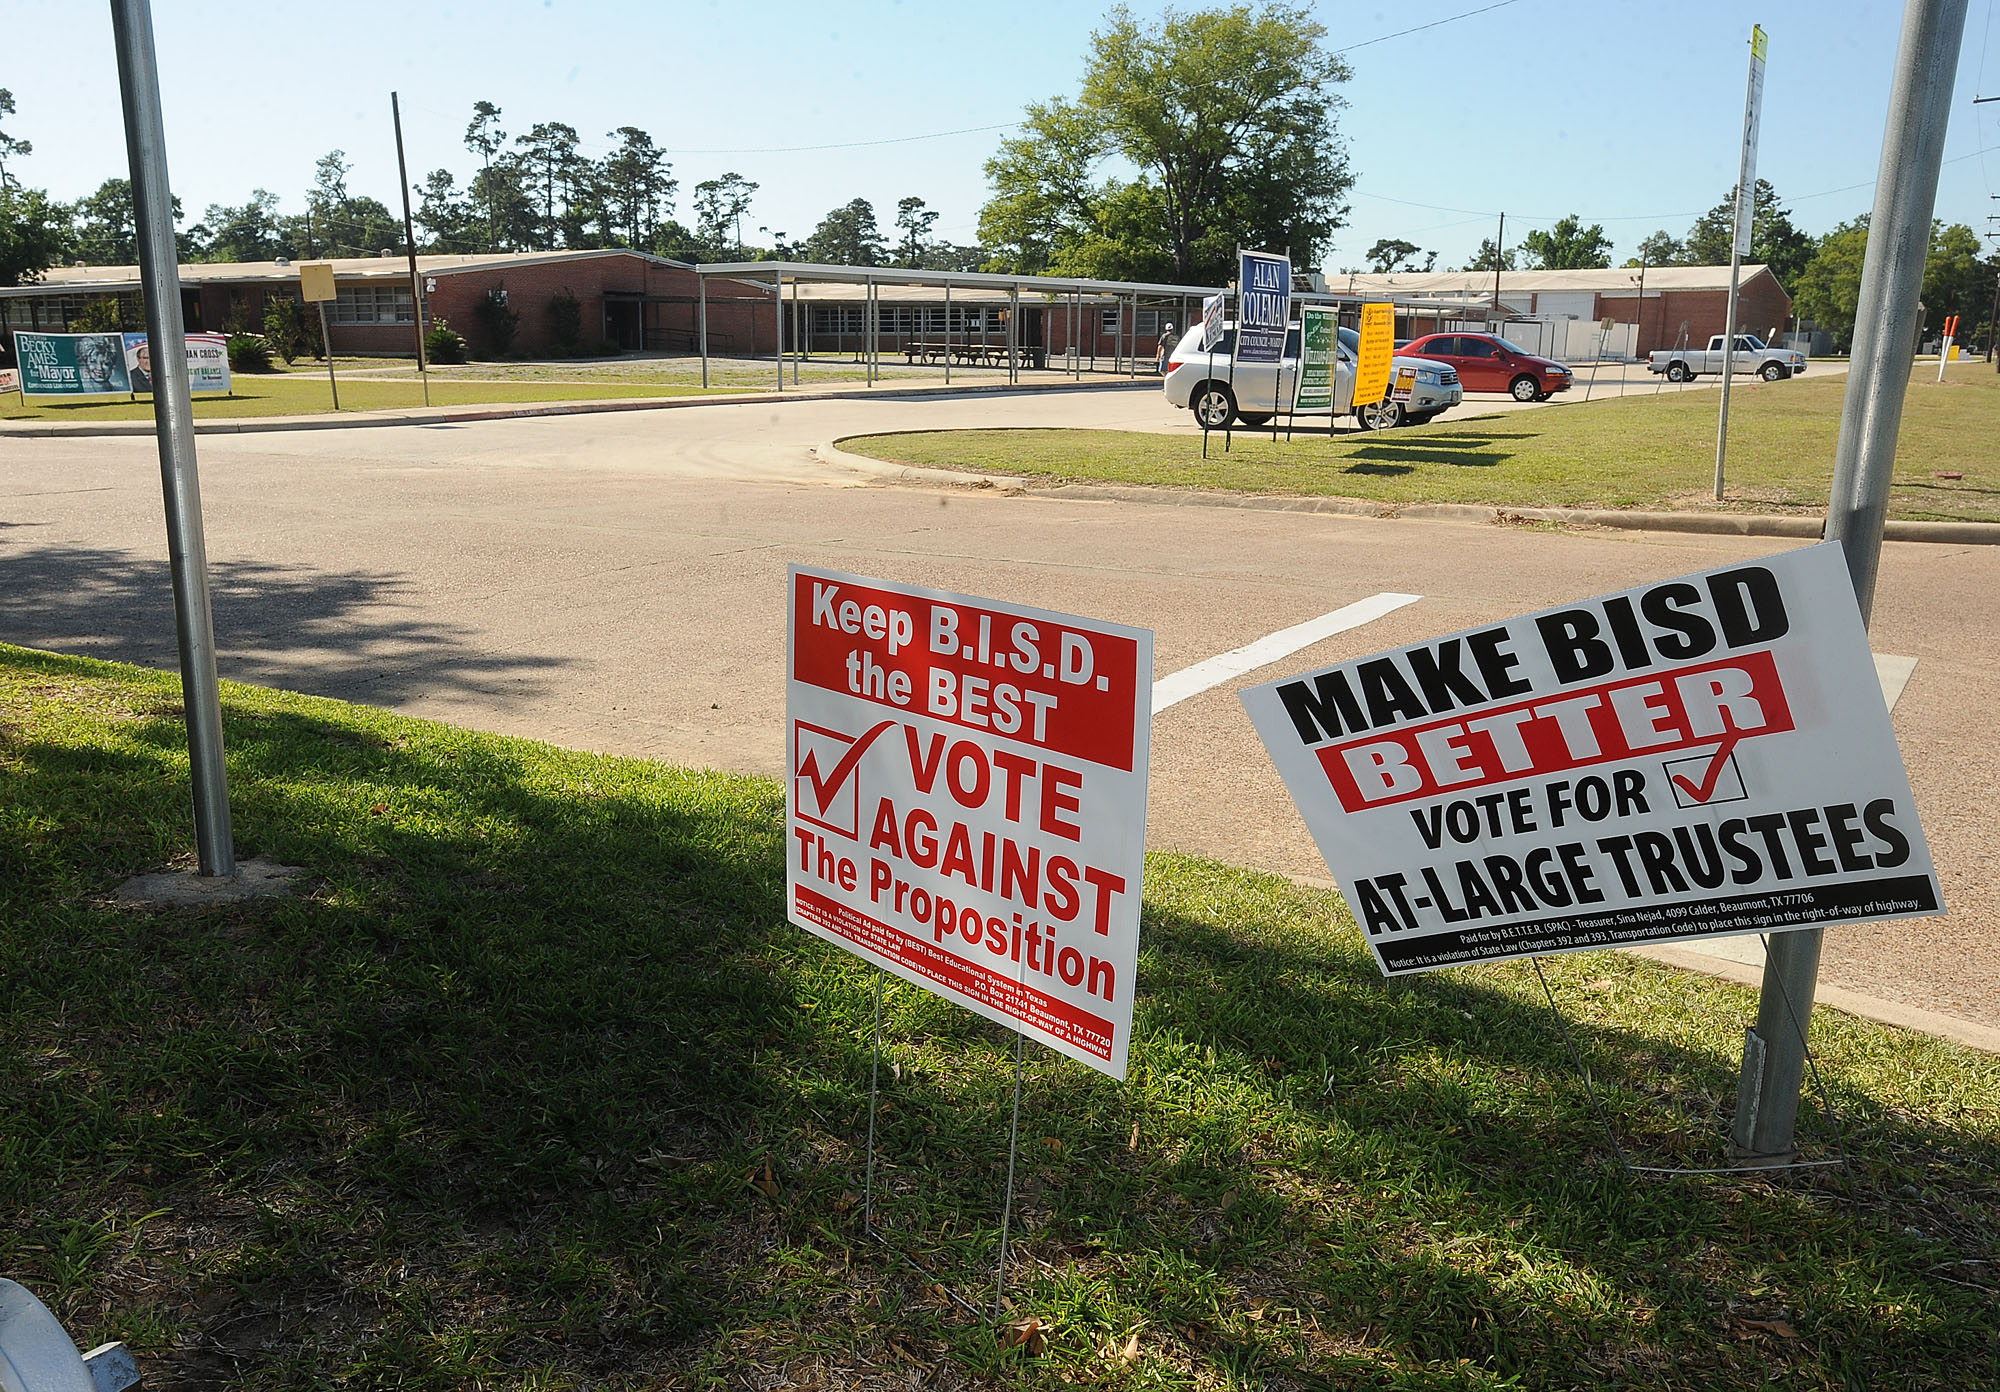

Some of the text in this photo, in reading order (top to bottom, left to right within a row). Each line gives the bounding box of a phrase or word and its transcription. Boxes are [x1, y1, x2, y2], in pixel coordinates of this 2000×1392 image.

[1242, 291, 1289, 327] COLEMAN
[1253, 263, 1280, 289] ALAN
[20, 335, 56, 353] BECKY
[27, 352, 59, 368] AMES
[38, 365, 76, 382] Mayor
[812, 582, 1110, 692] Keep B.I.S.D.
[1274, 565, 1790, 746] MAKE BISD
[846, 648, 1058, 743] the BEST
[1340, 667, 1768, 802] BETTER
[903, 723, 1083, 844] VOTE
[1409, 768, 1651, 850] VOTE FOR
[869, 796, 1126, 937] AGAINST
[1353, 797, 1911, 936] AT-LARGE TRUSTEES
[793, 825, 1116, 1003] The Proposition
[795, 897, 815, 912] NOTICE:
[832, 915, 861, 934] VIOLATION
[861, 928, 870, 937] OF
[870, 932, 888, 946] STATE
[888, 940, 901, 952] LAW
[838, 907, 1048, 1008] Political Ad paid for by (BEST) Best Educational System in Texas
[1389, 899, 1921, 968] Notice: It is a violation of State Law (Chapters 392 and 393, Transportation Code) to place this sign in the right-of-way of highway.
[1459, 933, 1479, 944] Paid
[1477, 932, 1490, 942] for
[1489, 930, 1501, 941] by
[1500, 924, 1544, 939] B.E.T.T.E.R.
[1543, 920, 1571, 934] (SPAC)
[1575, 917, 1617, 929] Treasurer,
[1616, 914, 1637, 925] Sina
[1635, 909, 1665, 923] Nejad,
[1665, 907, 1688, 918] 4099
[1688, 904, 1720, 916] Calder,
[1719, 899, 1771, 913] Beaumont,
[1769, 895, 1784, 907] TX
[1783, 892, 1815, 906] 77706
[822, 918, 831, 928] 392
[831, 923, 842, 933] AND
[842, 928, 854, 940] 393,
[853, 933, 901, 961] TRANSPORTATION
[927, 968, 947, 983] PLACE
[947, 978, 963, 990] THIS
[963, 985, 980, 998] SIGN
[981, 993, 989, 1002] IN
[989, 997, 1004, 1009] THE
[1004, 1003, 1054, 1032] RIGHT-OF-WAY
[1054, 1026, 1065, 1036] OF
[1065, 1032, 1072, 1041] A
[1072, 1035, 1109, 1058] HIGHWAY.
[974, 979, 1111, 1048] P.O. Box 21741 Beaumont, TX 77720
